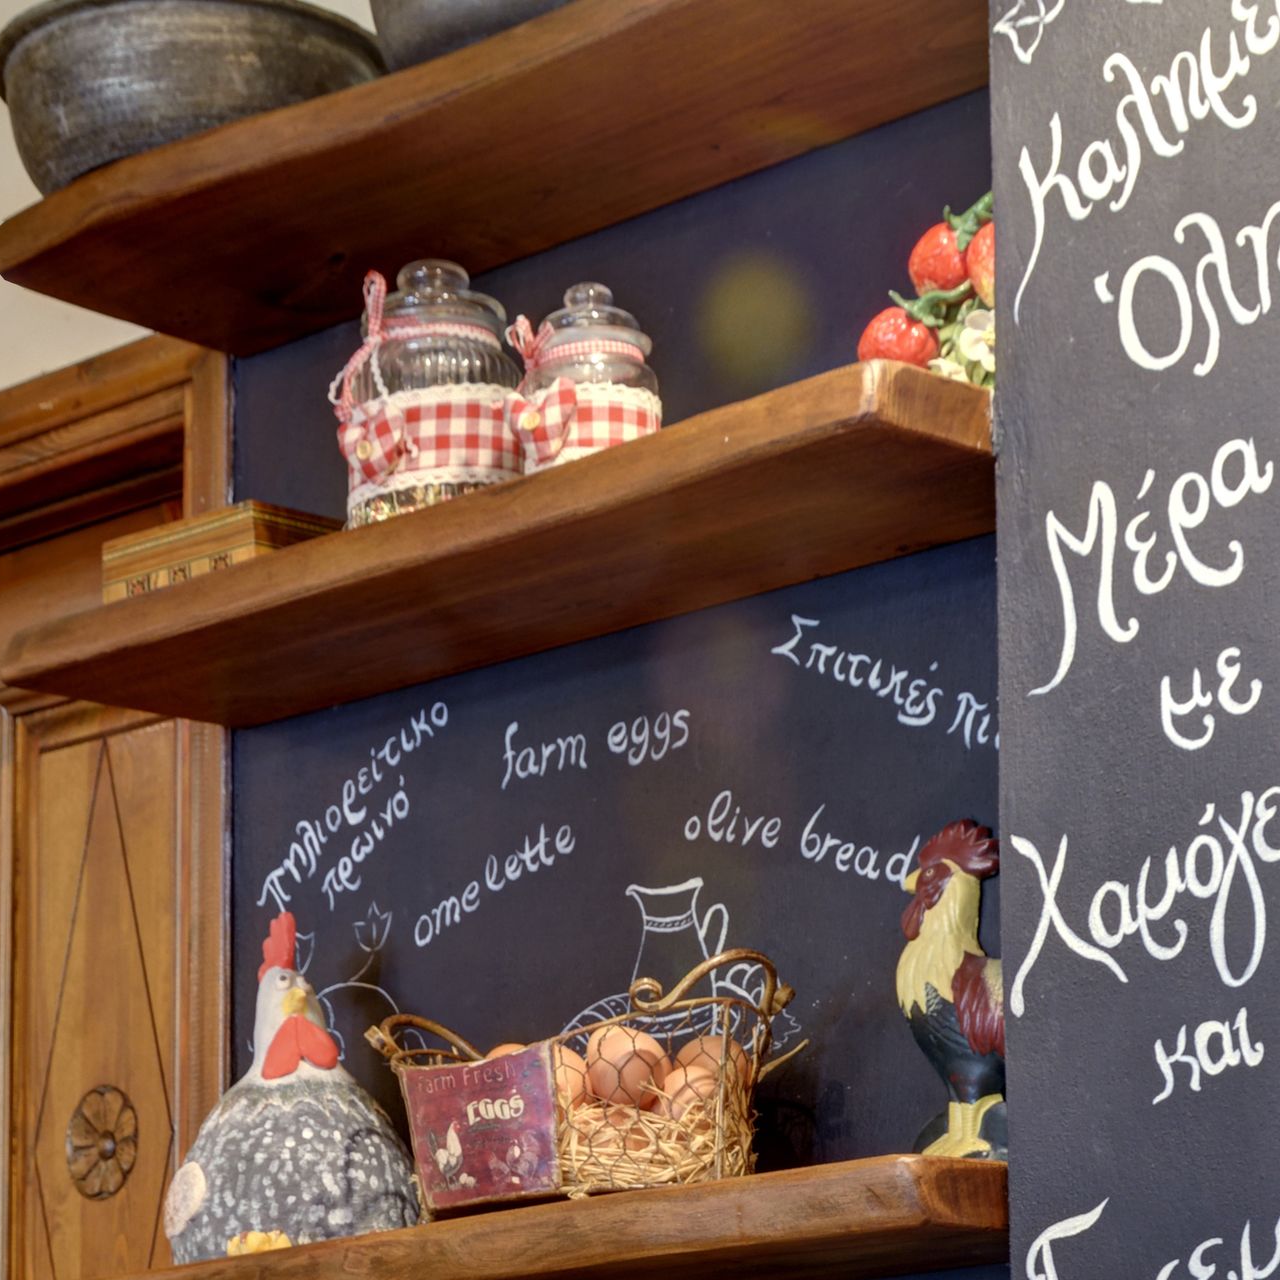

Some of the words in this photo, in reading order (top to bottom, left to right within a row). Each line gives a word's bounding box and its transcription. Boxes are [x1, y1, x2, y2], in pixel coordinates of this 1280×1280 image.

[1027, 436, 1274, 697] Μέρα
[770, 613, 944, 727] Σπιτικές
[946, 691, 1000, 751] πι
[1160, 646, 1262, 751] με
[500, 721, 588, 791] farm
[606, 708, 691, 767] eggs
[321, 774, 410, 912] πρωινό
[414, 822, 576, 948] omelette
[683, 789, 782, 849] olive
[799, 802, 920, 892] bread
[462, 1059, 517, 1087] Fresh
[1152, 1006, 1265, 1106] και
[466, 1094, 525, 1127] EGGS
